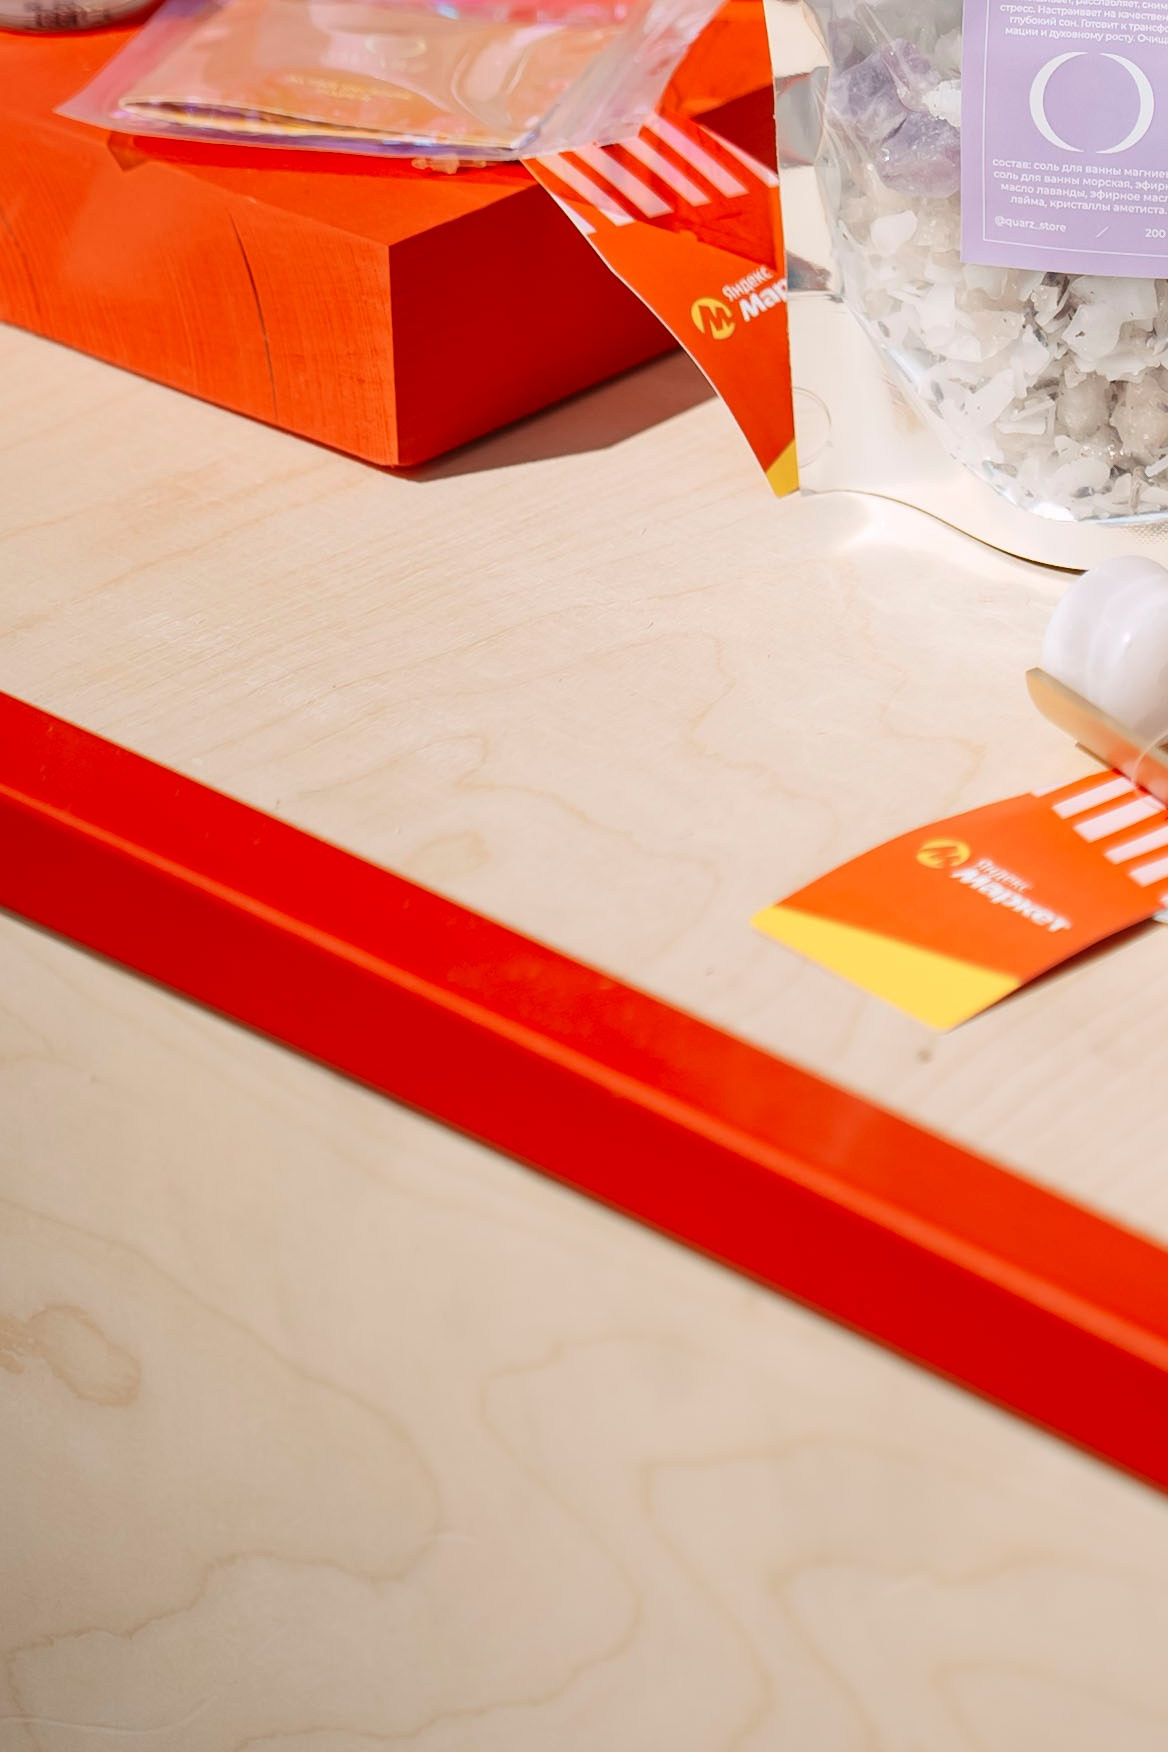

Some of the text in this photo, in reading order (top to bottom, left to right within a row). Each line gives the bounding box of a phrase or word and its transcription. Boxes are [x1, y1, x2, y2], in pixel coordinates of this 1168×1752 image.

[1038, 5, 1103, 17] Настраивает
[1104, 10, 1116, 18] на
[1009, 15, 1057, 26] глубокий
[1081, 19, 1119, 29] Готовит
[1005, 27, 1039, 37] мации
[1040, 29, 1048, 37] и
[1048, 29, 1104, 42] духовному
[1033, 162, 1060, 172] соль
[1061, 164, 1083, 173] для
[1085, 165, 1122, 176] ванны
[993, 171, 1019, 180] соль
[1020, 173, 1041, 183] для
[1044, 174, 1080, 185] ванны
[1000, 183, 1035, 194] масло
[1036, 186, 1088, 199] лаванды,
[1089, 189, 1141, 202] эфирное
[1010, 195, 1168, 215] лайма, кристаллы аметиста.
[1145, 228, 1166, 239] 200
[722, 264, 774, 302] Яндекс
[739, 278, 788, 322] Мар
[949, 868, 1072, 932] Маркет
